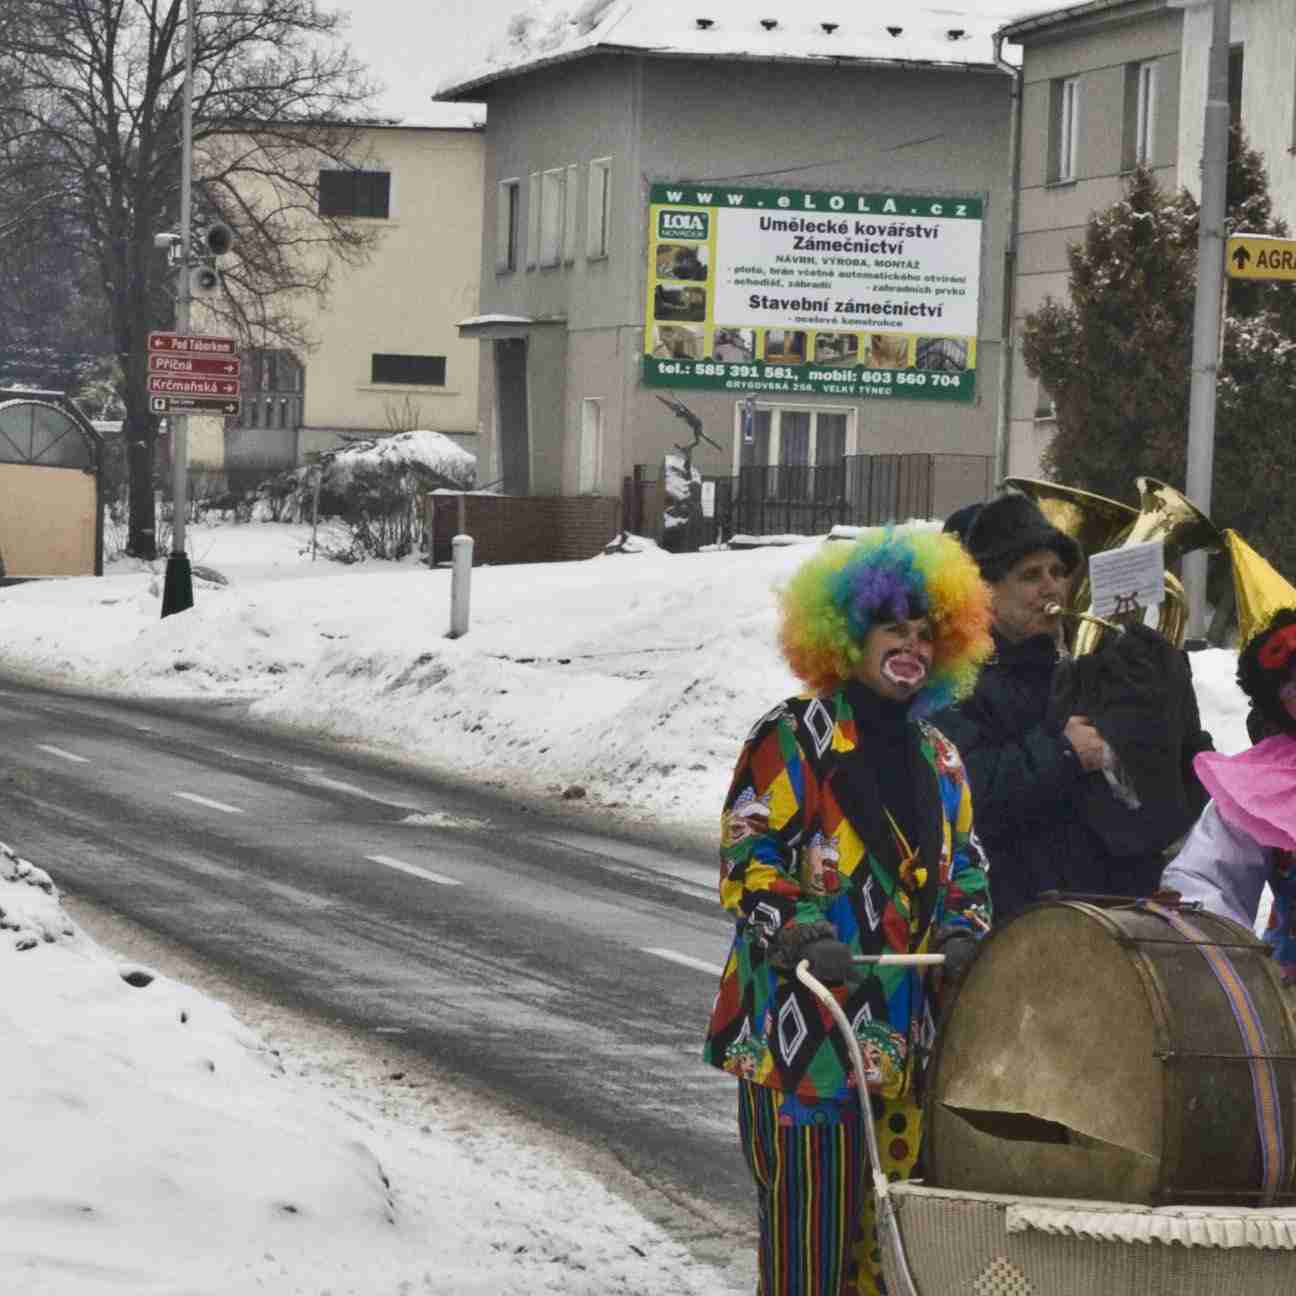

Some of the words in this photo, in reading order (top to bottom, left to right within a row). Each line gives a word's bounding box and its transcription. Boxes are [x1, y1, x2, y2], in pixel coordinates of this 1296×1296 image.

[666, 191, 968, 217] www.eLOLA.cz
[759, 216, 849, 235] Umělecké
[855, 220, 940, 239] kovářství
[793, 236, 904, 255] Zámečnictví
[874, 258, 921, 270] MONTÁŽ
[749, 294, 831, 313] Stavební
[834, 298, 944, 317] zámečnictví
[155, 357, 193, 371] Příčná
[657, 362, 691, 375] tel.:
[695, 363, 725, 376] 585
[729, 365, 760, 378] 391
[808, 369, 857, 382] mobil:
[861, 371, 892, 384] 603
[896, 372, 927, 385] 560
[930, 374, 961, 387] 704
[152, 377, 218, 393] Krčmaňská
